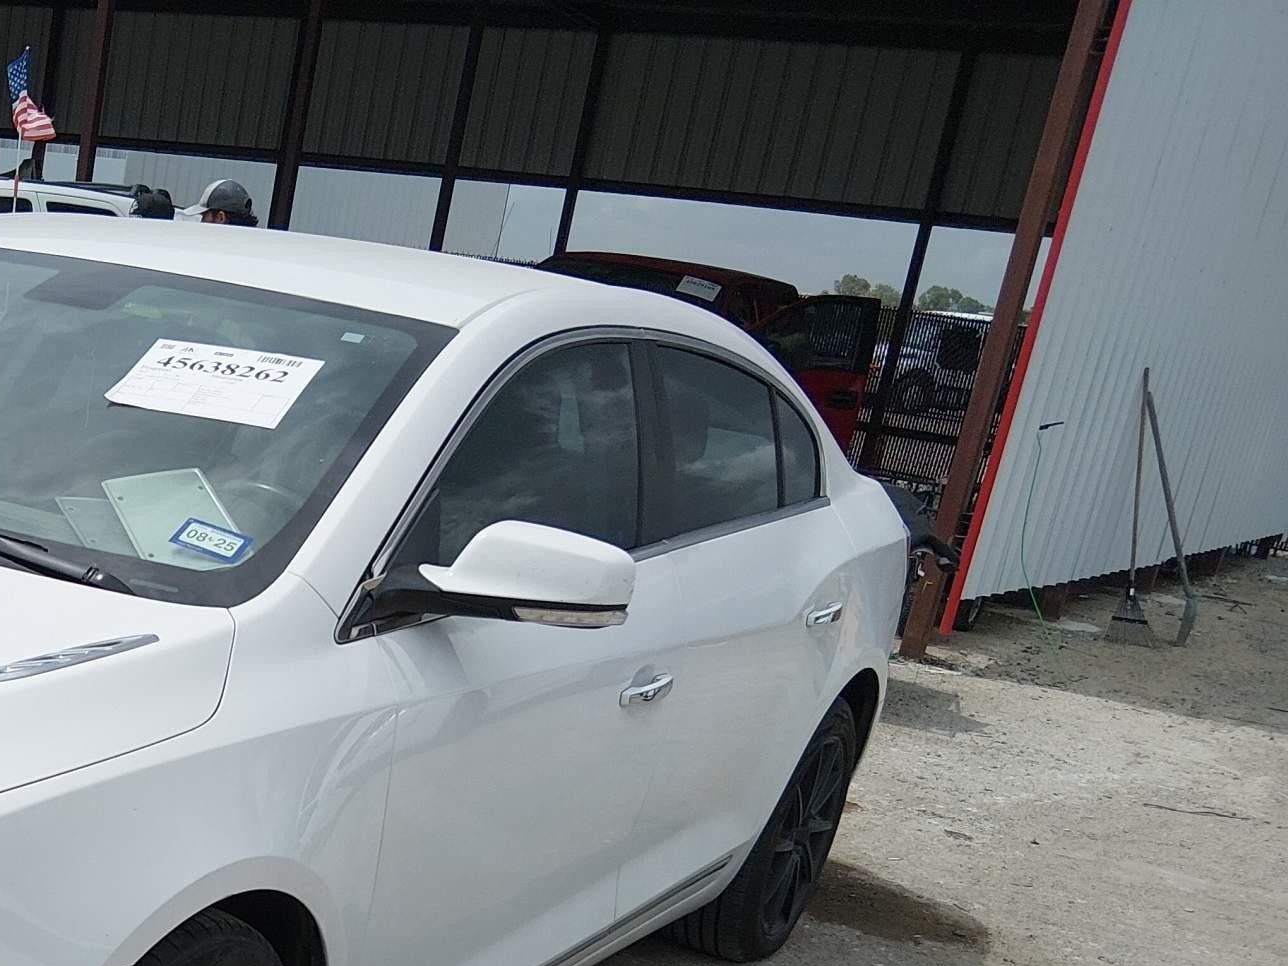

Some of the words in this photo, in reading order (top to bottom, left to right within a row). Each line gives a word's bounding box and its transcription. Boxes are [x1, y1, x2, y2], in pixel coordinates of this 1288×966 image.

[156, 356, 289, 383] 45638262
[186, 529, 209, 543] 08
[213, 538, 238, 552] 25
